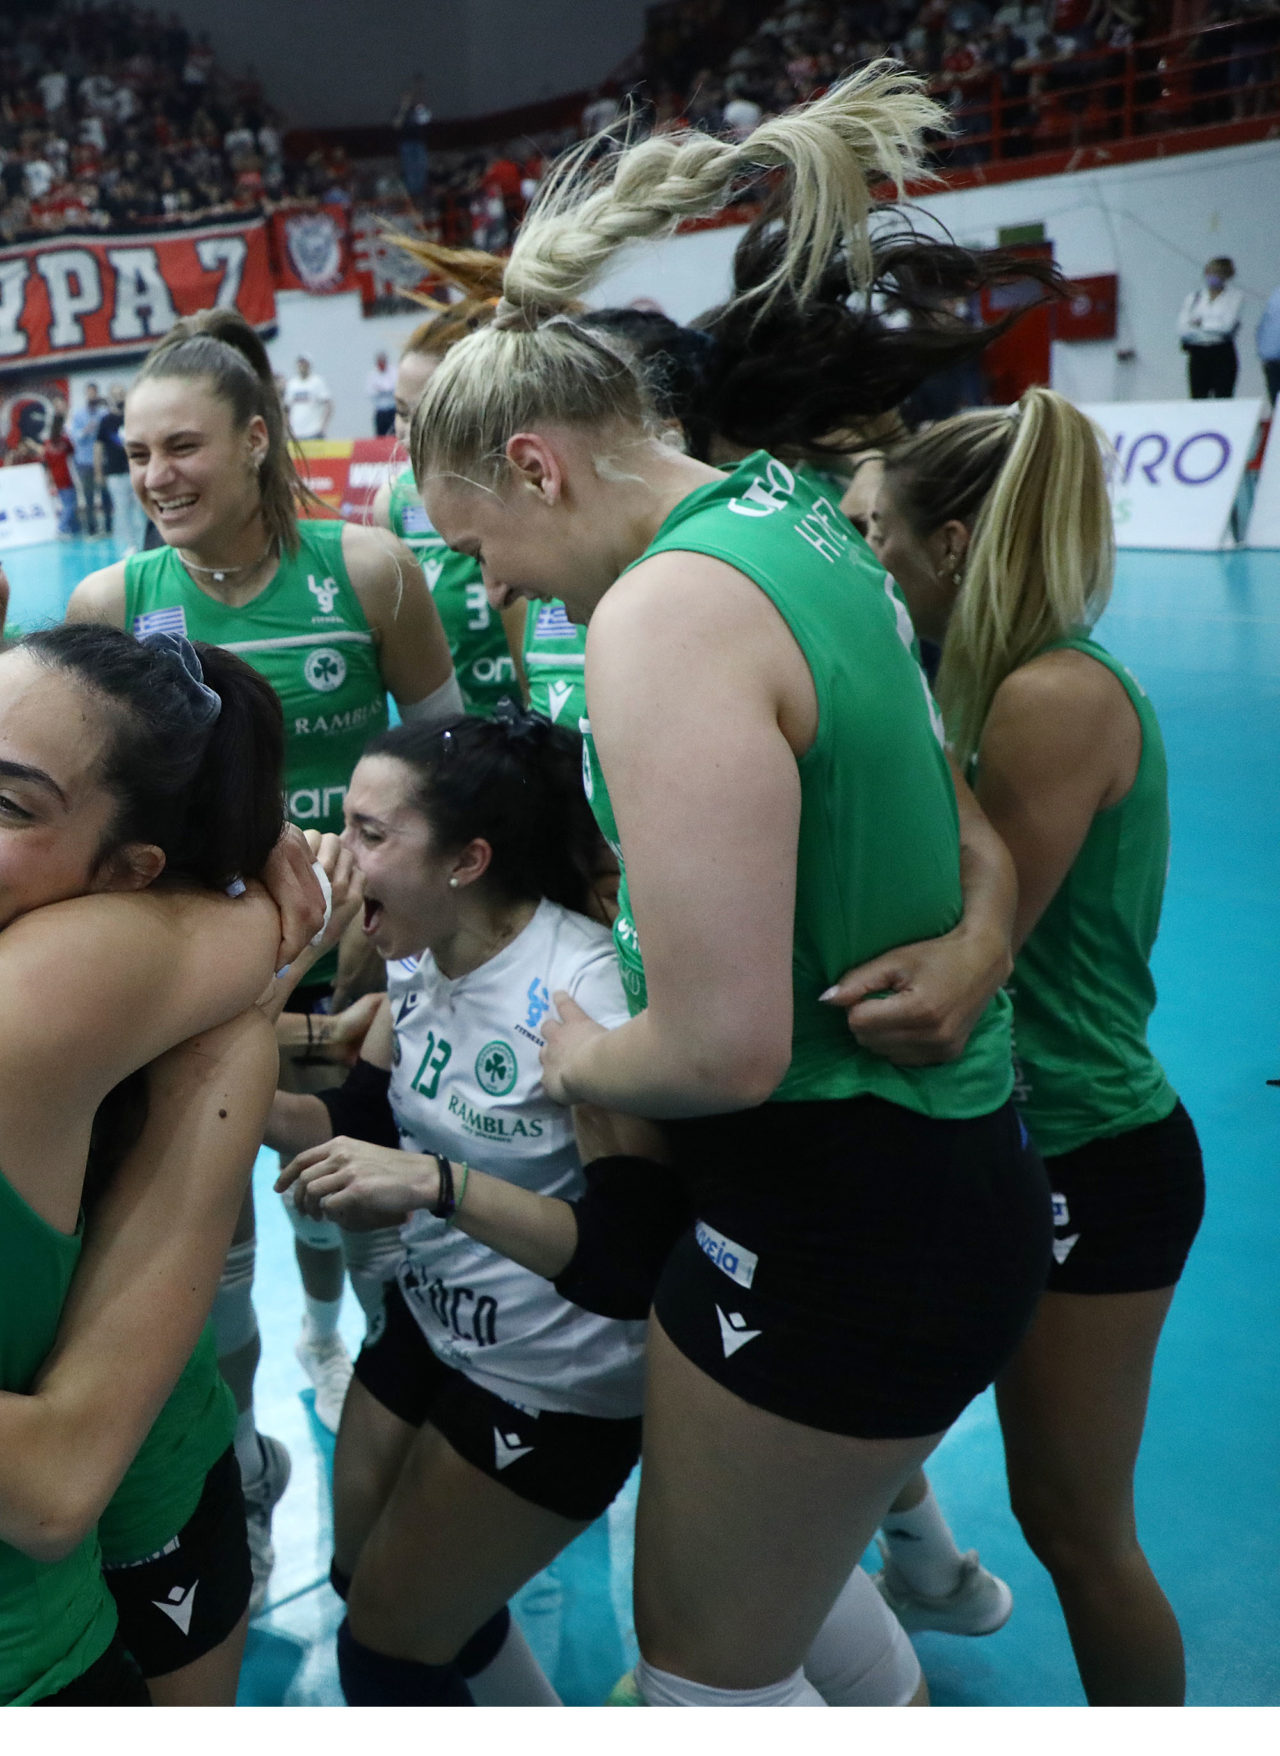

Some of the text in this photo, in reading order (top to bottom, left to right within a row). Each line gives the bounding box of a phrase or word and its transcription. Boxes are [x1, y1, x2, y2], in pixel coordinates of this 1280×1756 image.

[195, 235, 248, 309] 7
[411, 1031, 452, 1099] 13
[448, 1095, 544, 1138] RAMBLAS
